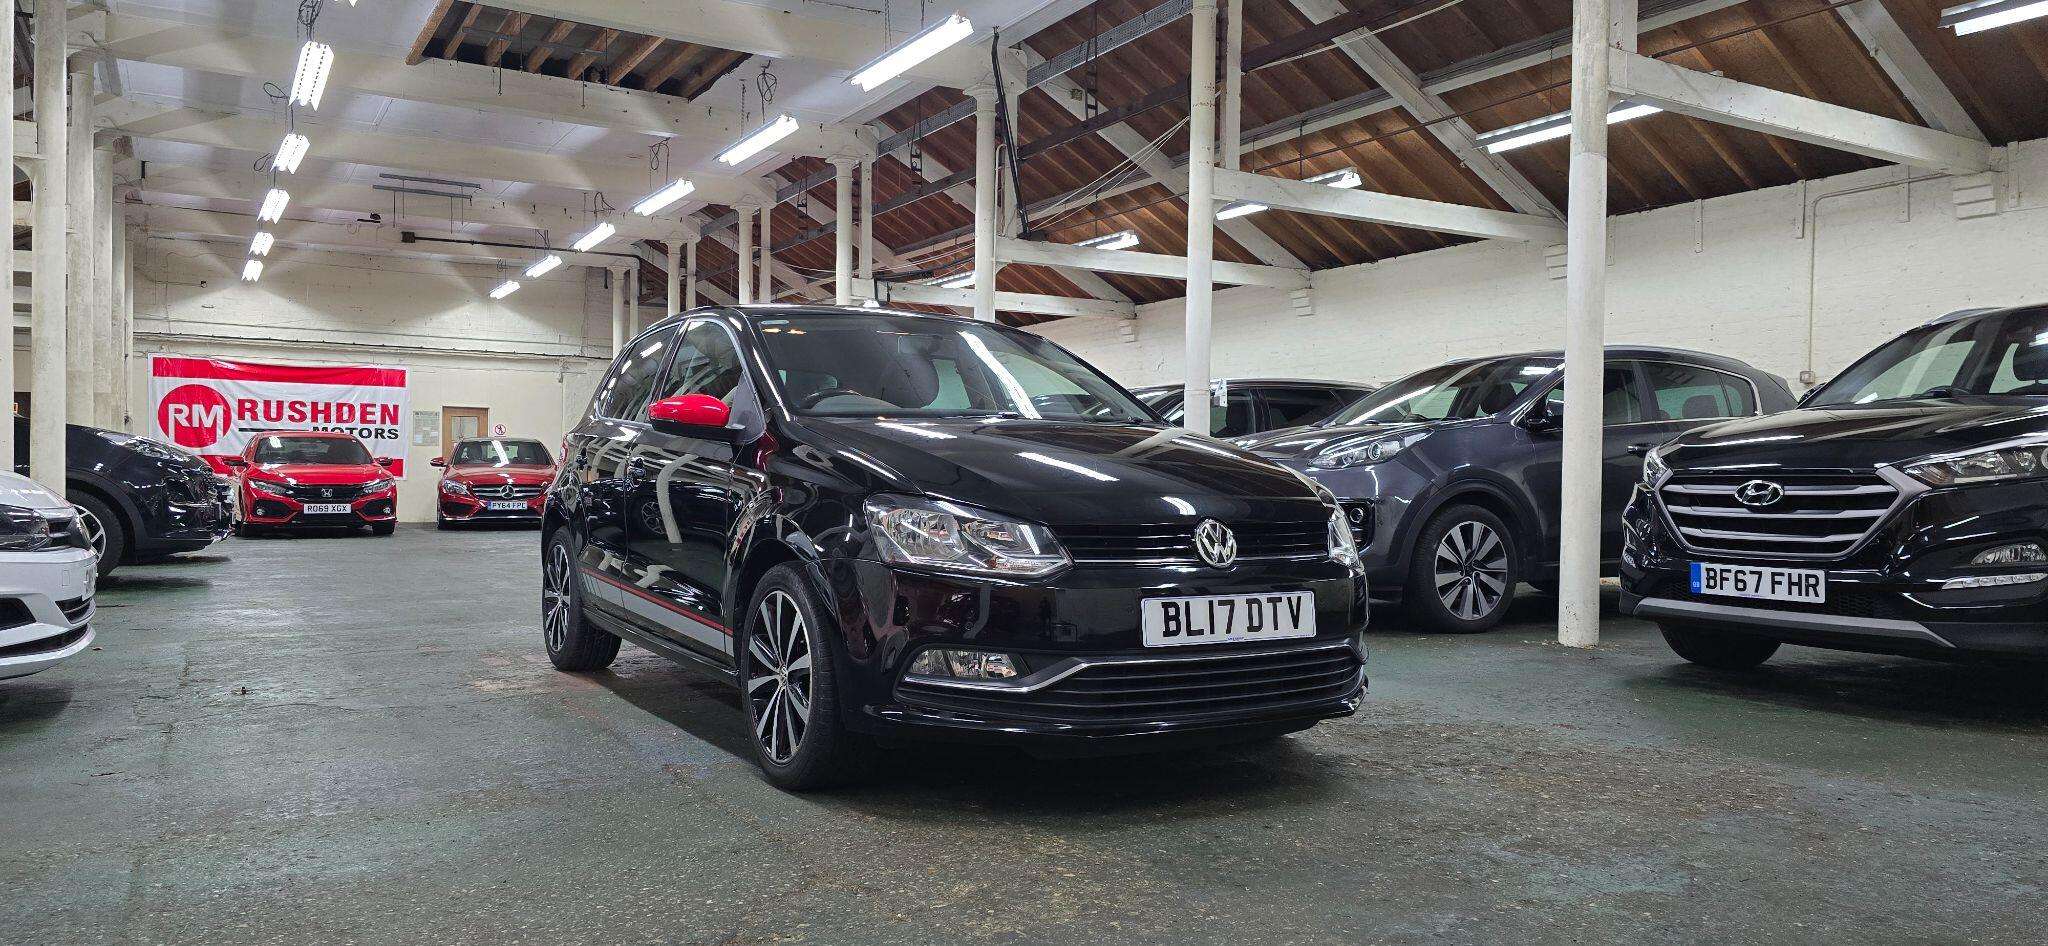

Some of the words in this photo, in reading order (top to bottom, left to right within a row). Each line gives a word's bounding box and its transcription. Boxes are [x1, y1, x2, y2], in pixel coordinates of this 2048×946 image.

[168, 403, 223, 440] RM
[237, 398, 400, 425] RUSHDEN
[307, 504, 329, 513] RO69
[331, 504, 348, 512] XGX
[1705, 567, 1763, 593] BF67
[1770, 571, 1820, 597] FHR
[1162, 600, 1235, 637] BL17
[1246, 595, 1302, 632] DTV
